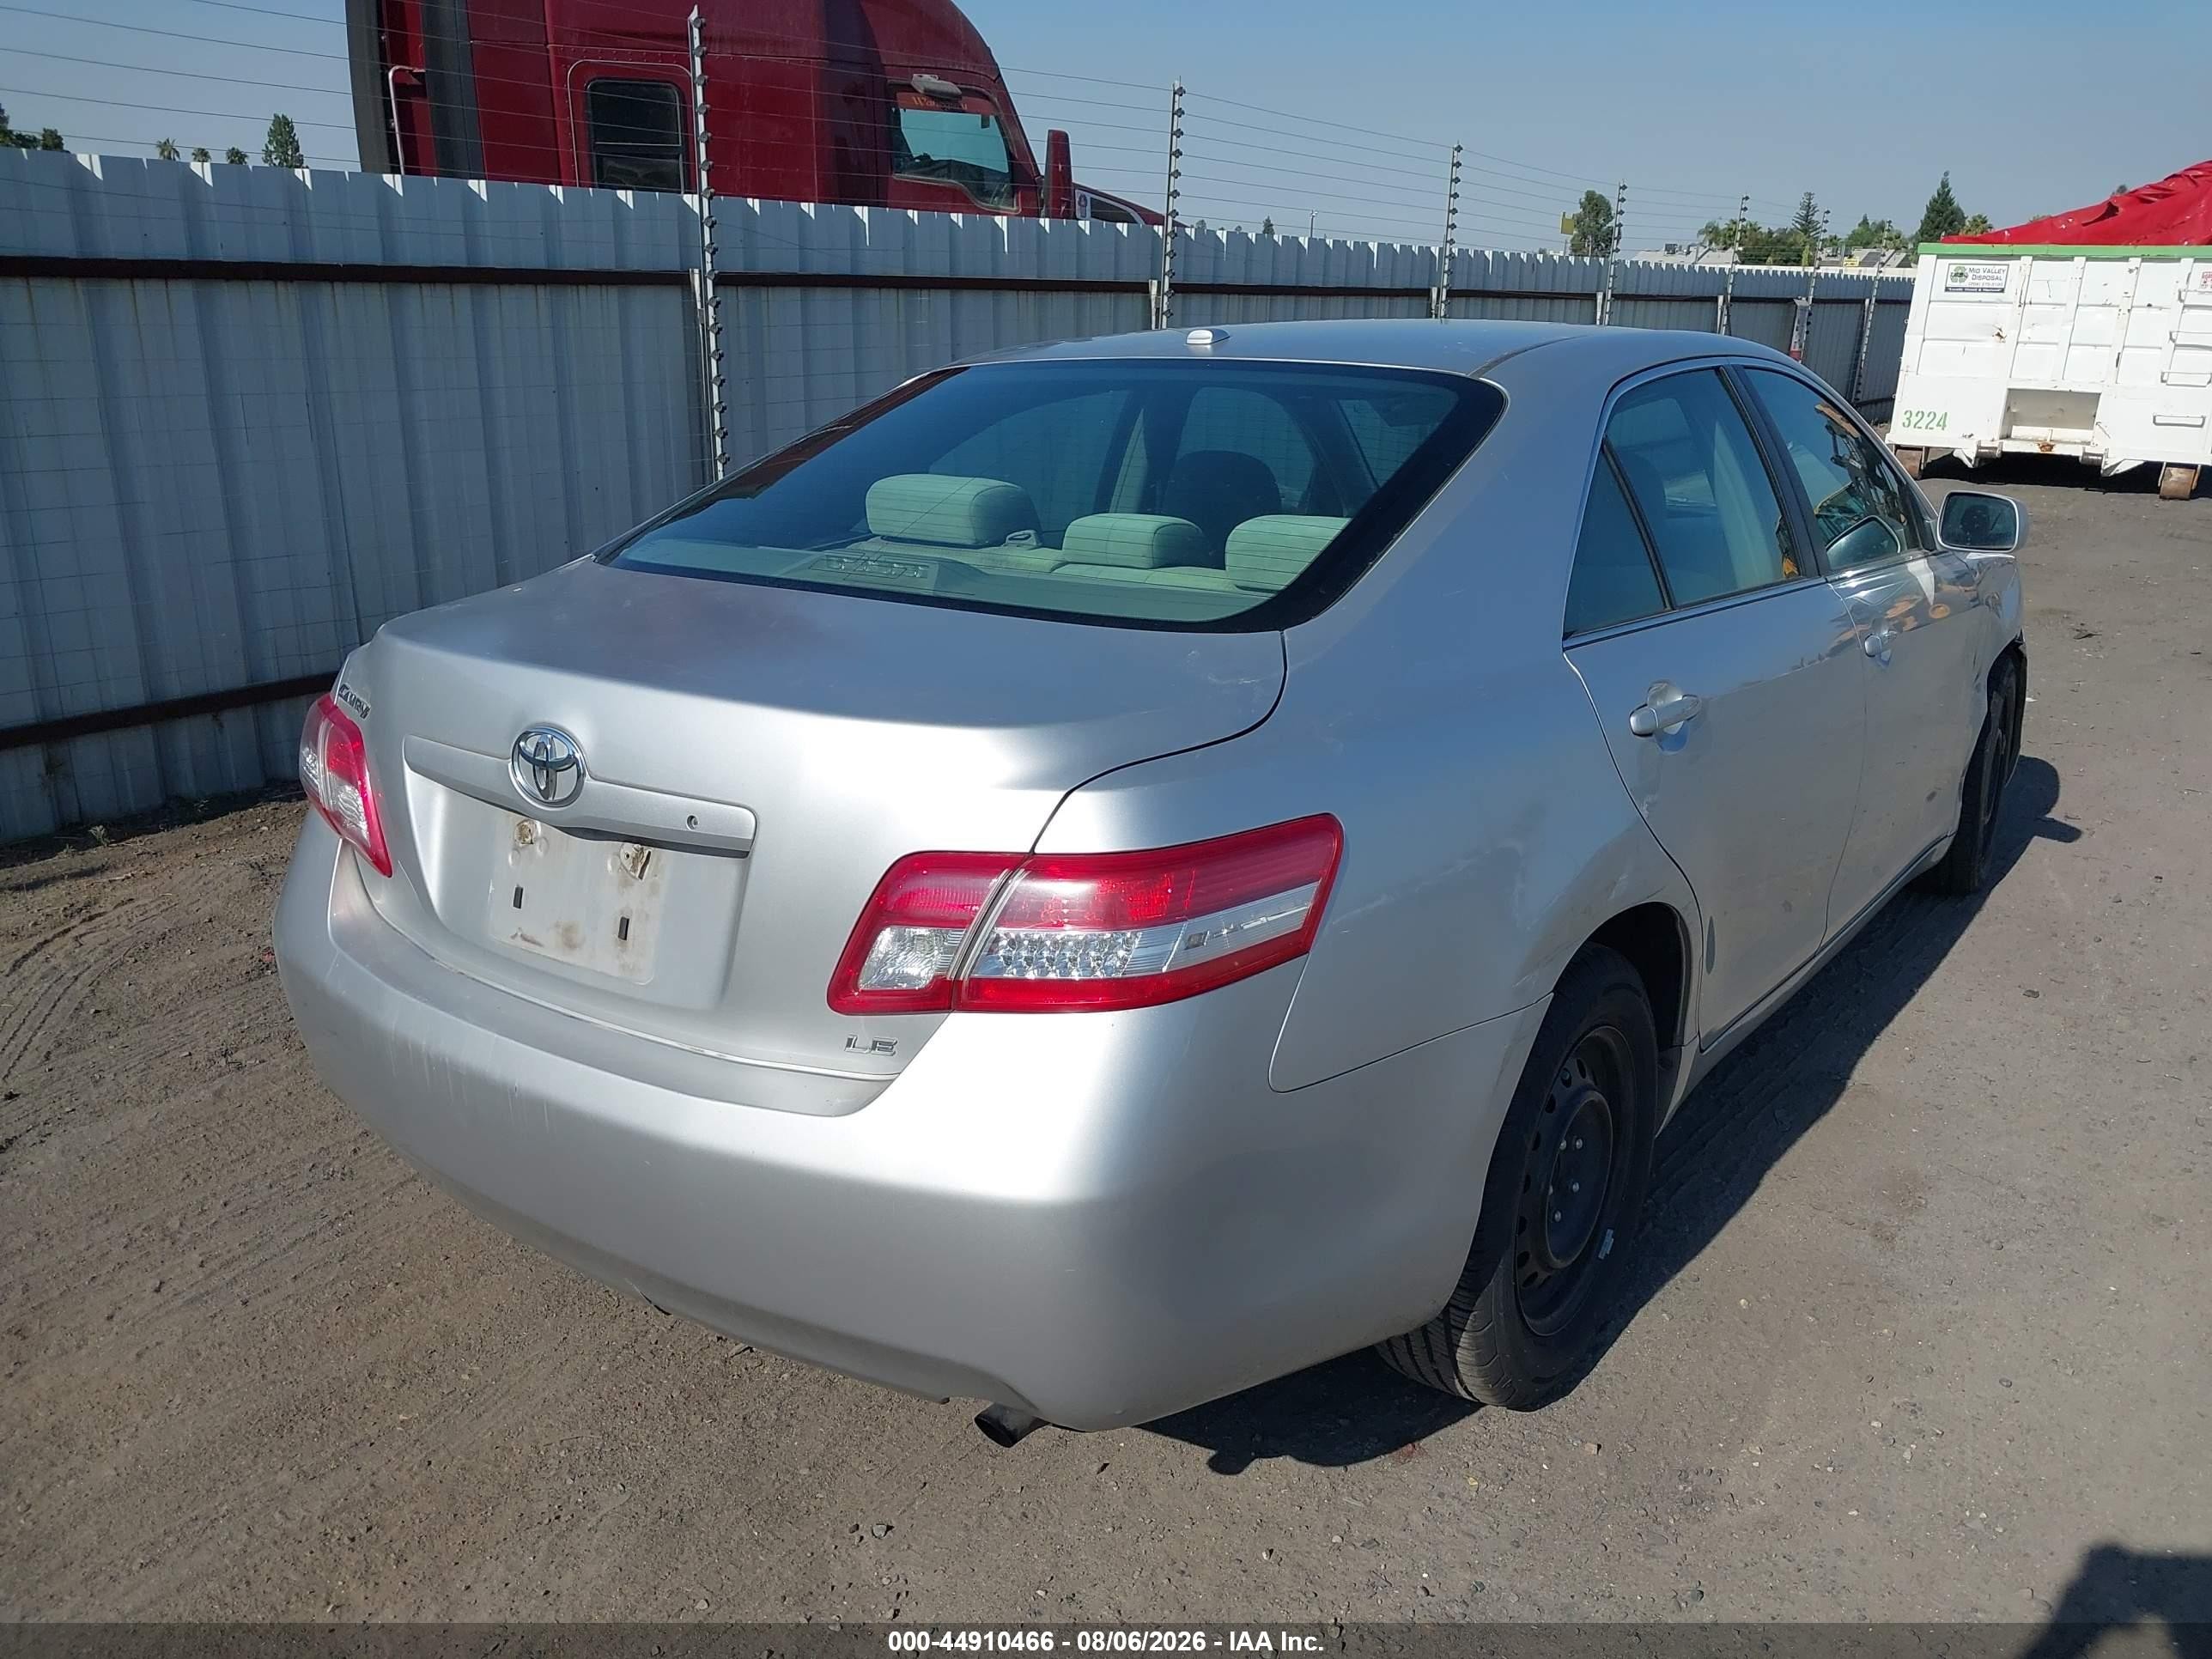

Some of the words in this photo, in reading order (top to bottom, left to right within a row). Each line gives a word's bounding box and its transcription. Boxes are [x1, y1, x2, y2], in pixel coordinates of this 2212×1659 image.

[1902, 410, 1948, 431] 3224
[337, 684, 371, 720] CAMRY
[843, 1034, 898, 1057] LE
